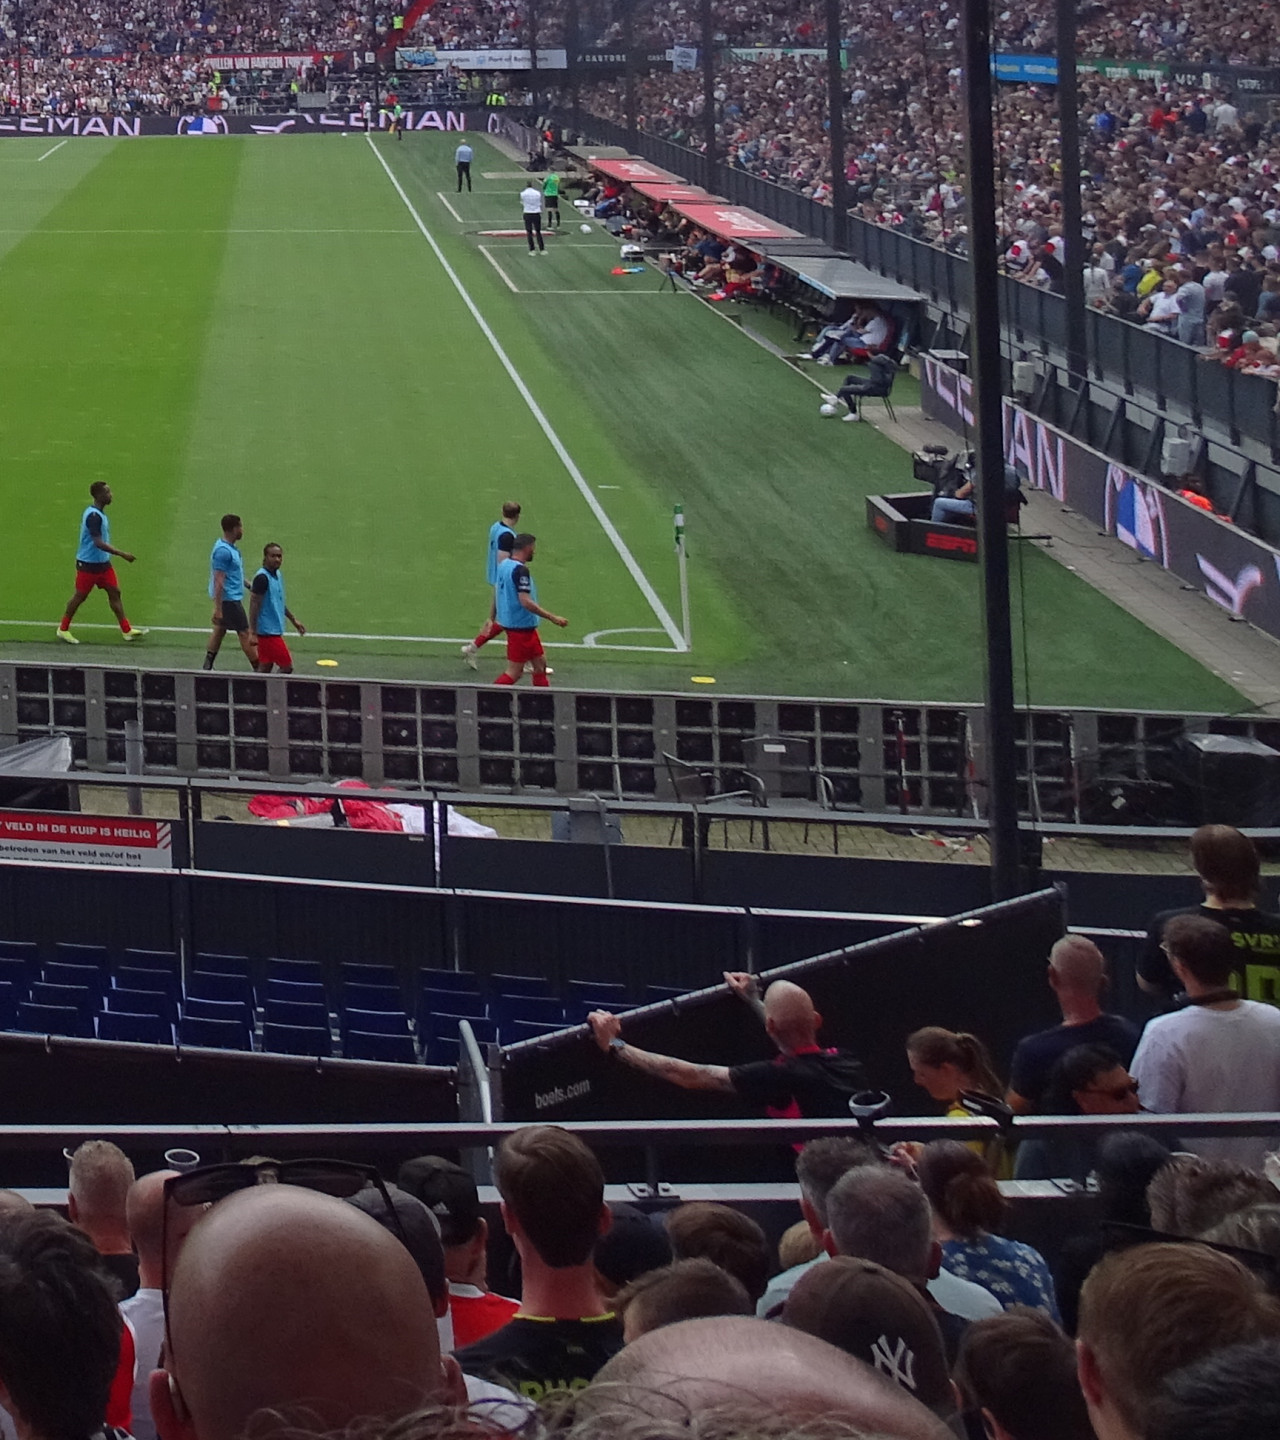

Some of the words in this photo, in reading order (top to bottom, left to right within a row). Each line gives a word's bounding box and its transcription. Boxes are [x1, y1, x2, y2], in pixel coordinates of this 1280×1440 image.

[925, 533, 977, 553] ESPN
[6, 822, 33, 832] VELD
[37, 824, 48, 832] IN
[52, 824, 67, 833] DE
[70, 825, 97, 836] KUIP
[100, 828, 111, 836] IS
[114, 828, 151, 839] HEILIG
[0, 844, 38, 854] betreden
[60, 847, 75, 856] het
[78, 849, 97, 858] veld
[100, 851, 124, 859] en/of
[126, 852, 141, 860] het
[535, 1079, 591, 1109] boels.com
[871, 1334, 917, 1390] NY
